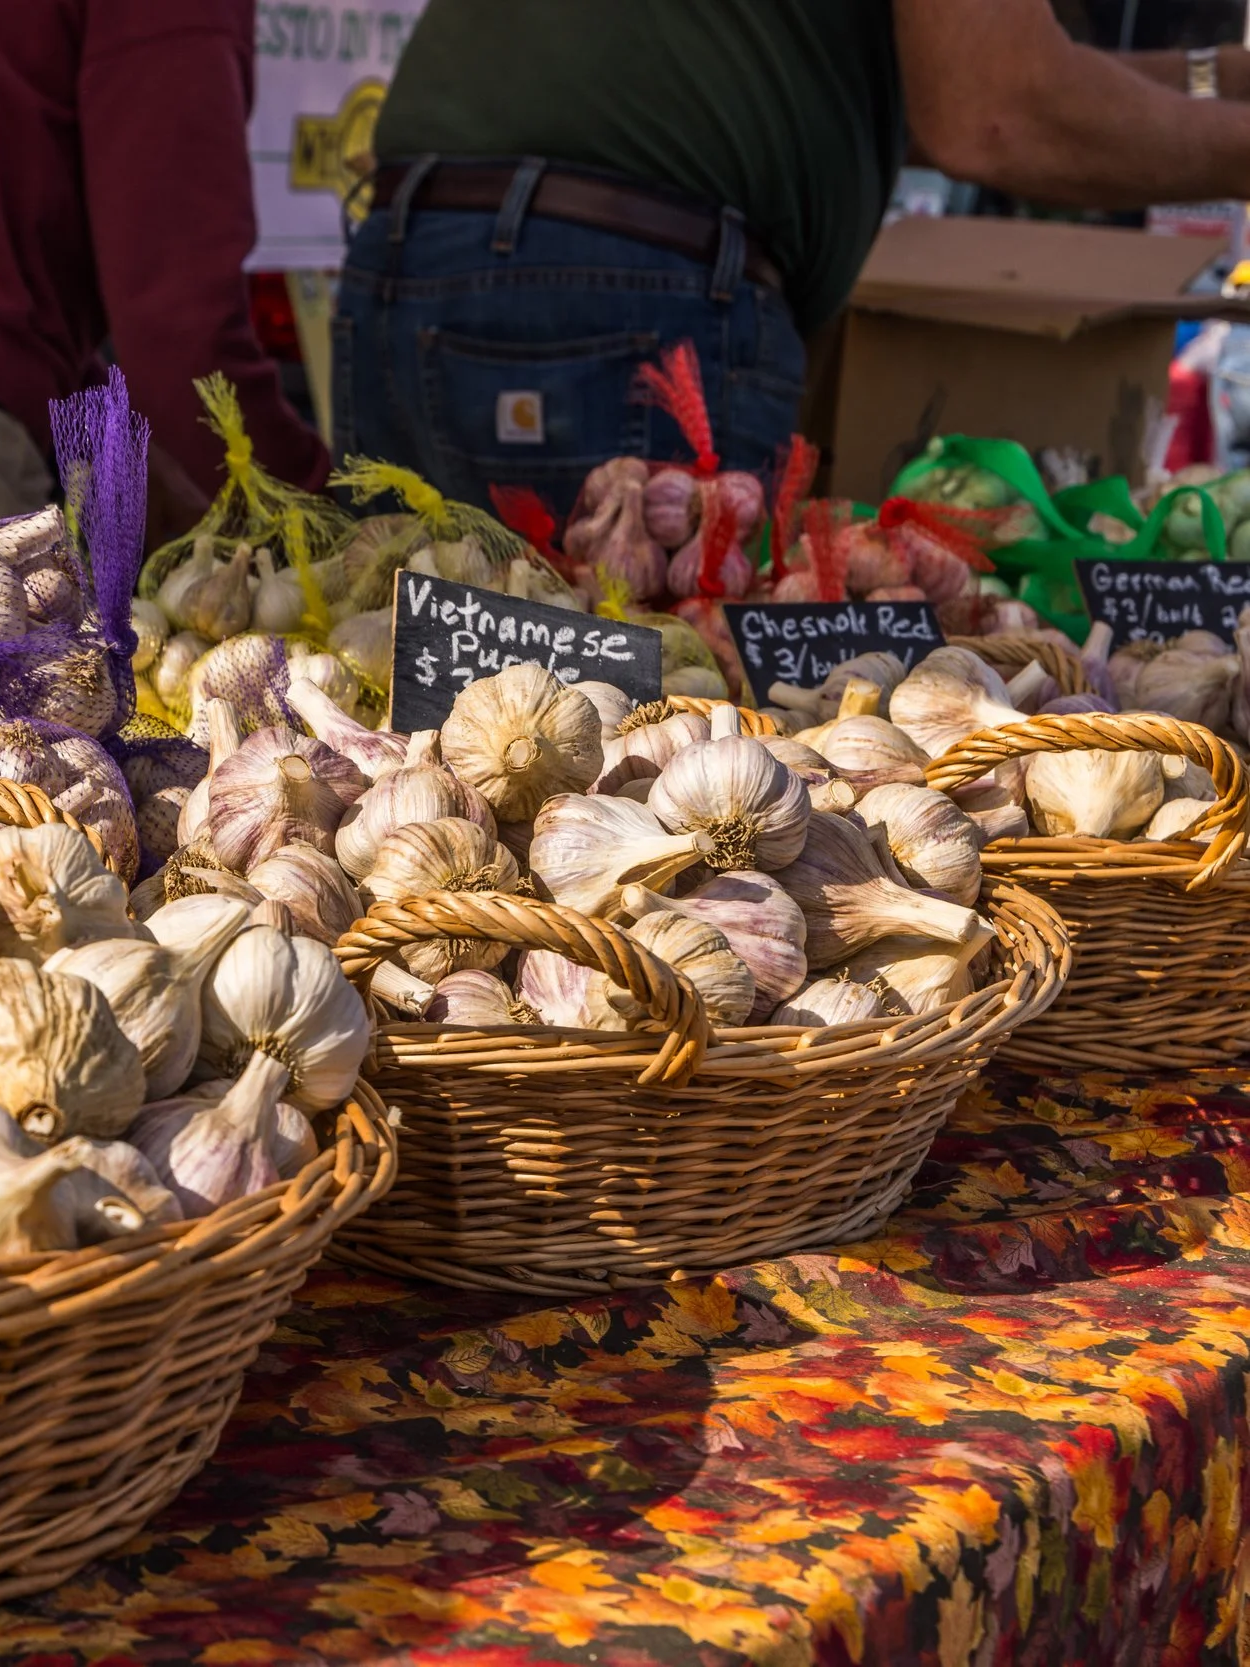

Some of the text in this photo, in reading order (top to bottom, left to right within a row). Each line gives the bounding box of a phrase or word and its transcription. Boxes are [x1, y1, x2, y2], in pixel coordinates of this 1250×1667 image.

[1091, 562, 1201, 593] German
[407, 577, 635, 661] Vietnamese
[740, 605, 938, 641] Chesnok Red
